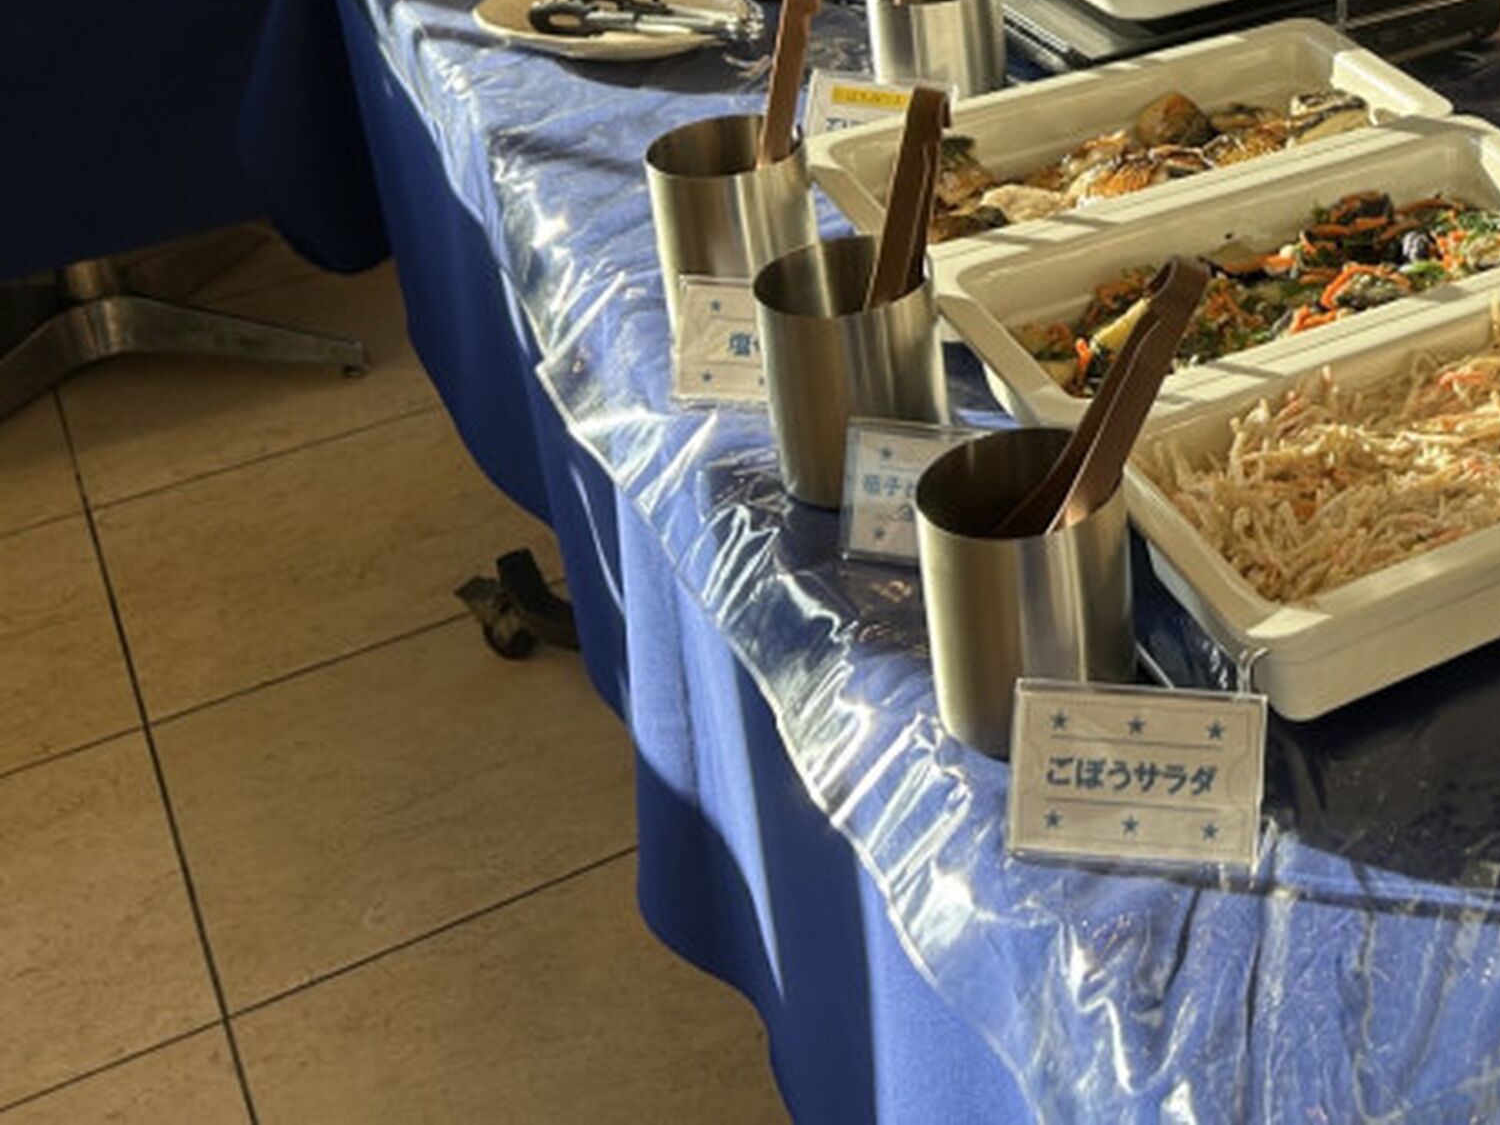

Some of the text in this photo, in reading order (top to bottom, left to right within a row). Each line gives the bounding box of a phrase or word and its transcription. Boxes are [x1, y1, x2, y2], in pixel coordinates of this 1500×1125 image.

[1046, 755, 1218, 797] ごぼうサラダ
